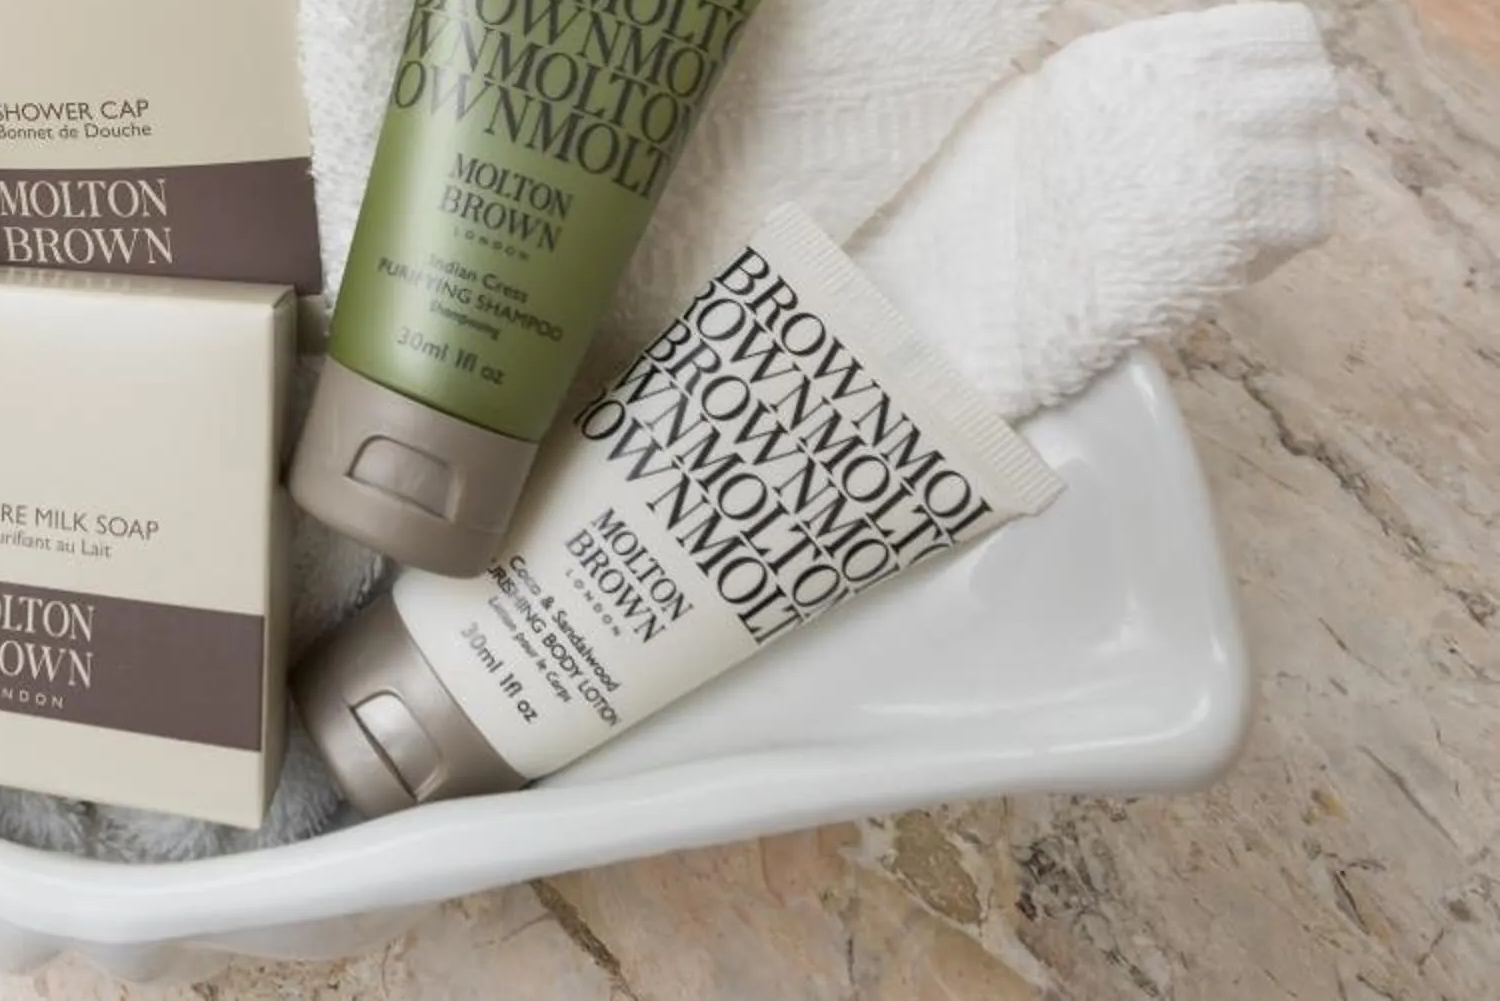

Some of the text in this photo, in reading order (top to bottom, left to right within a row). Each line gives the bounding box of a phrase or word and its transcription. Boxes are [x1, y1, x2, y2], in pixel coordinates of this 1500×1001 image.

[59, 124, 78, 139] de
[84, 122, 153, 139] Douche
[100, 99, 149, 120] CAP
[450, 153, 574, 219] MOLTON
[3, 225, 174, 264] BROWN
[440, 184, 563, 253] BROWN
[477, 294, 564, 343] SHAMPOO
[397, 327, 449, 362] 30ml
[481, 365, 506, 385] oz
[34, 507, 88, 533] MILK
[95, 515, 160, 541] SOAP
[56, 540, 76, 554] au
[81, 540, 112, 559] Lait
[565, 529, 666, 644] BROWN
[591, 507, 694, 622] MOLTON
[509, 555, 621, 693] Coco & Sandalwood
[565, 568, 621, 636] LONDON
[460, 622, 504, 674] 30ml
[517, 700, 539, 724] oz
[542, 633, 584, 678] BODY
